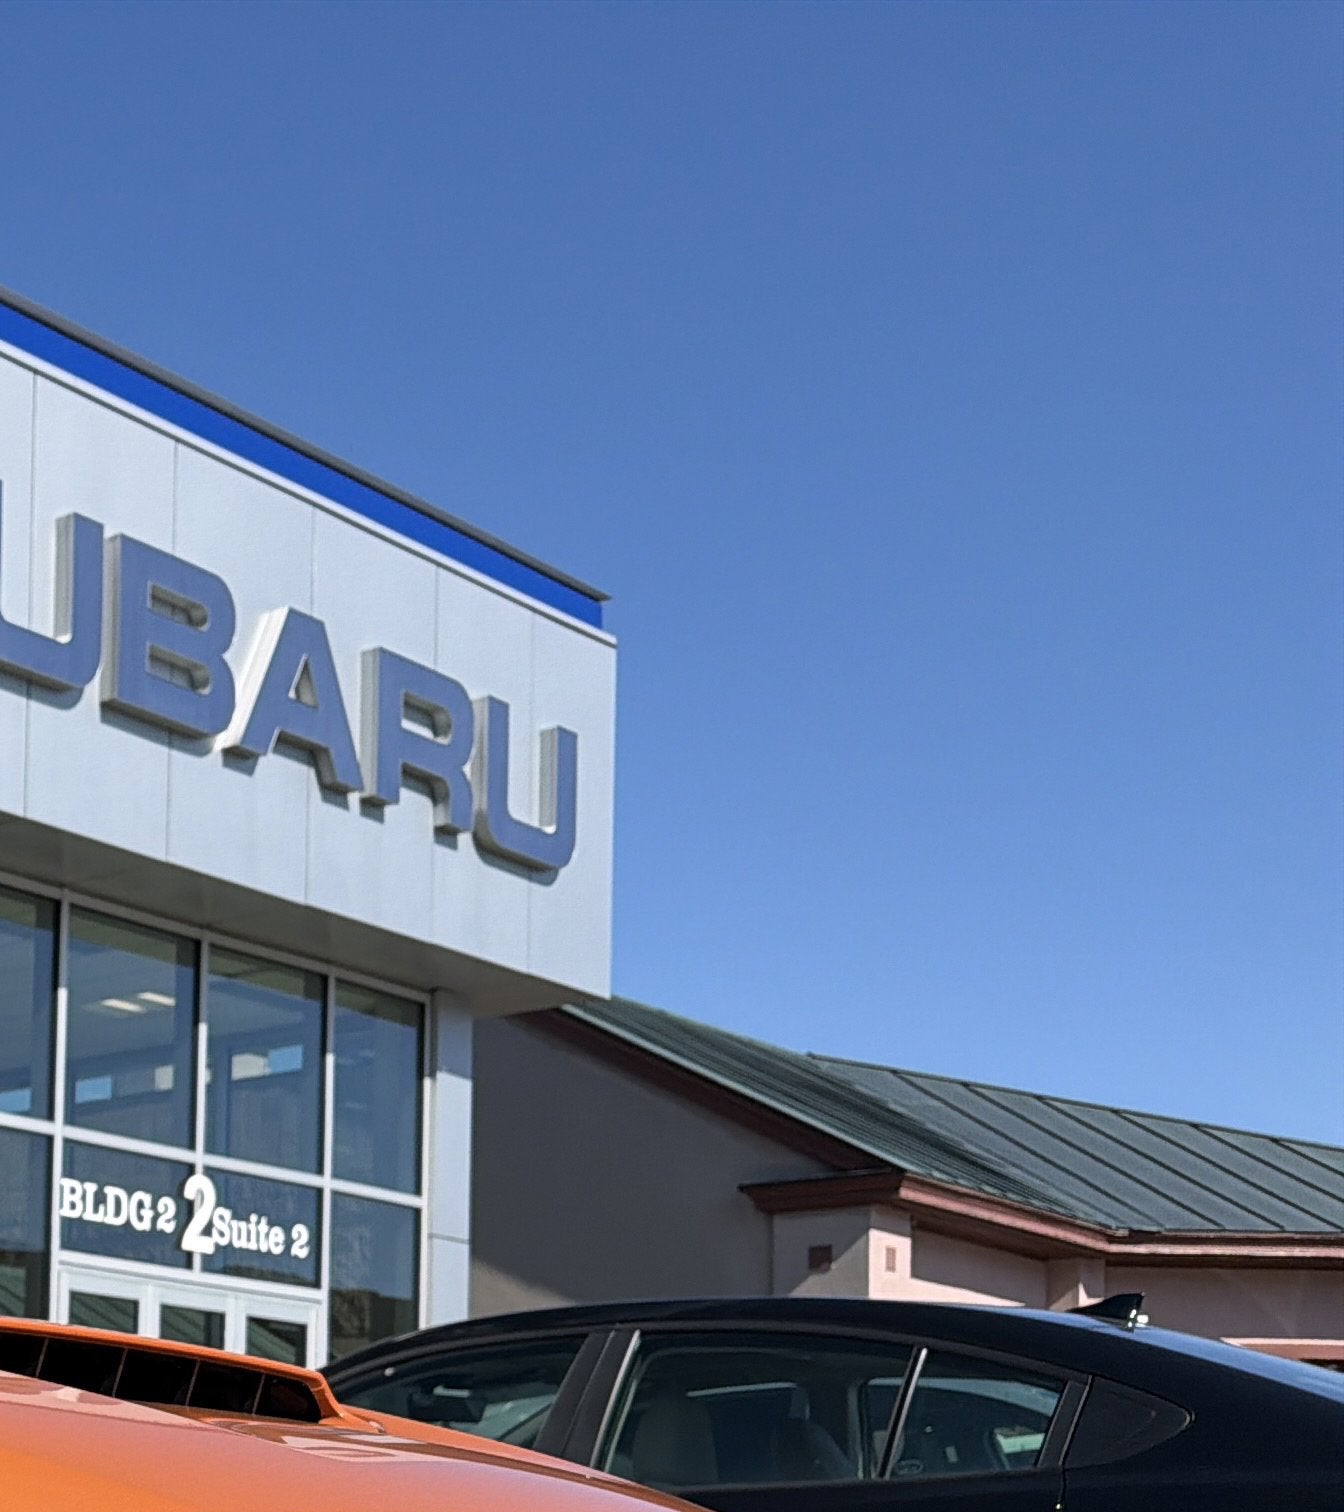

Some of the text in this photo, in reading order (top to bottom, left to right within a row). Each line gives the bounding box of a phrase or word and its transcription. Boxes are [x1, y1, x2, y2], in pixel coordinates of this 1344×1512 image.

[59, 1177, 178, 1235] BLDG 2
[180, 1173, 217, 1256] 2
[212, 1206, 311, 1260] Suite 2
